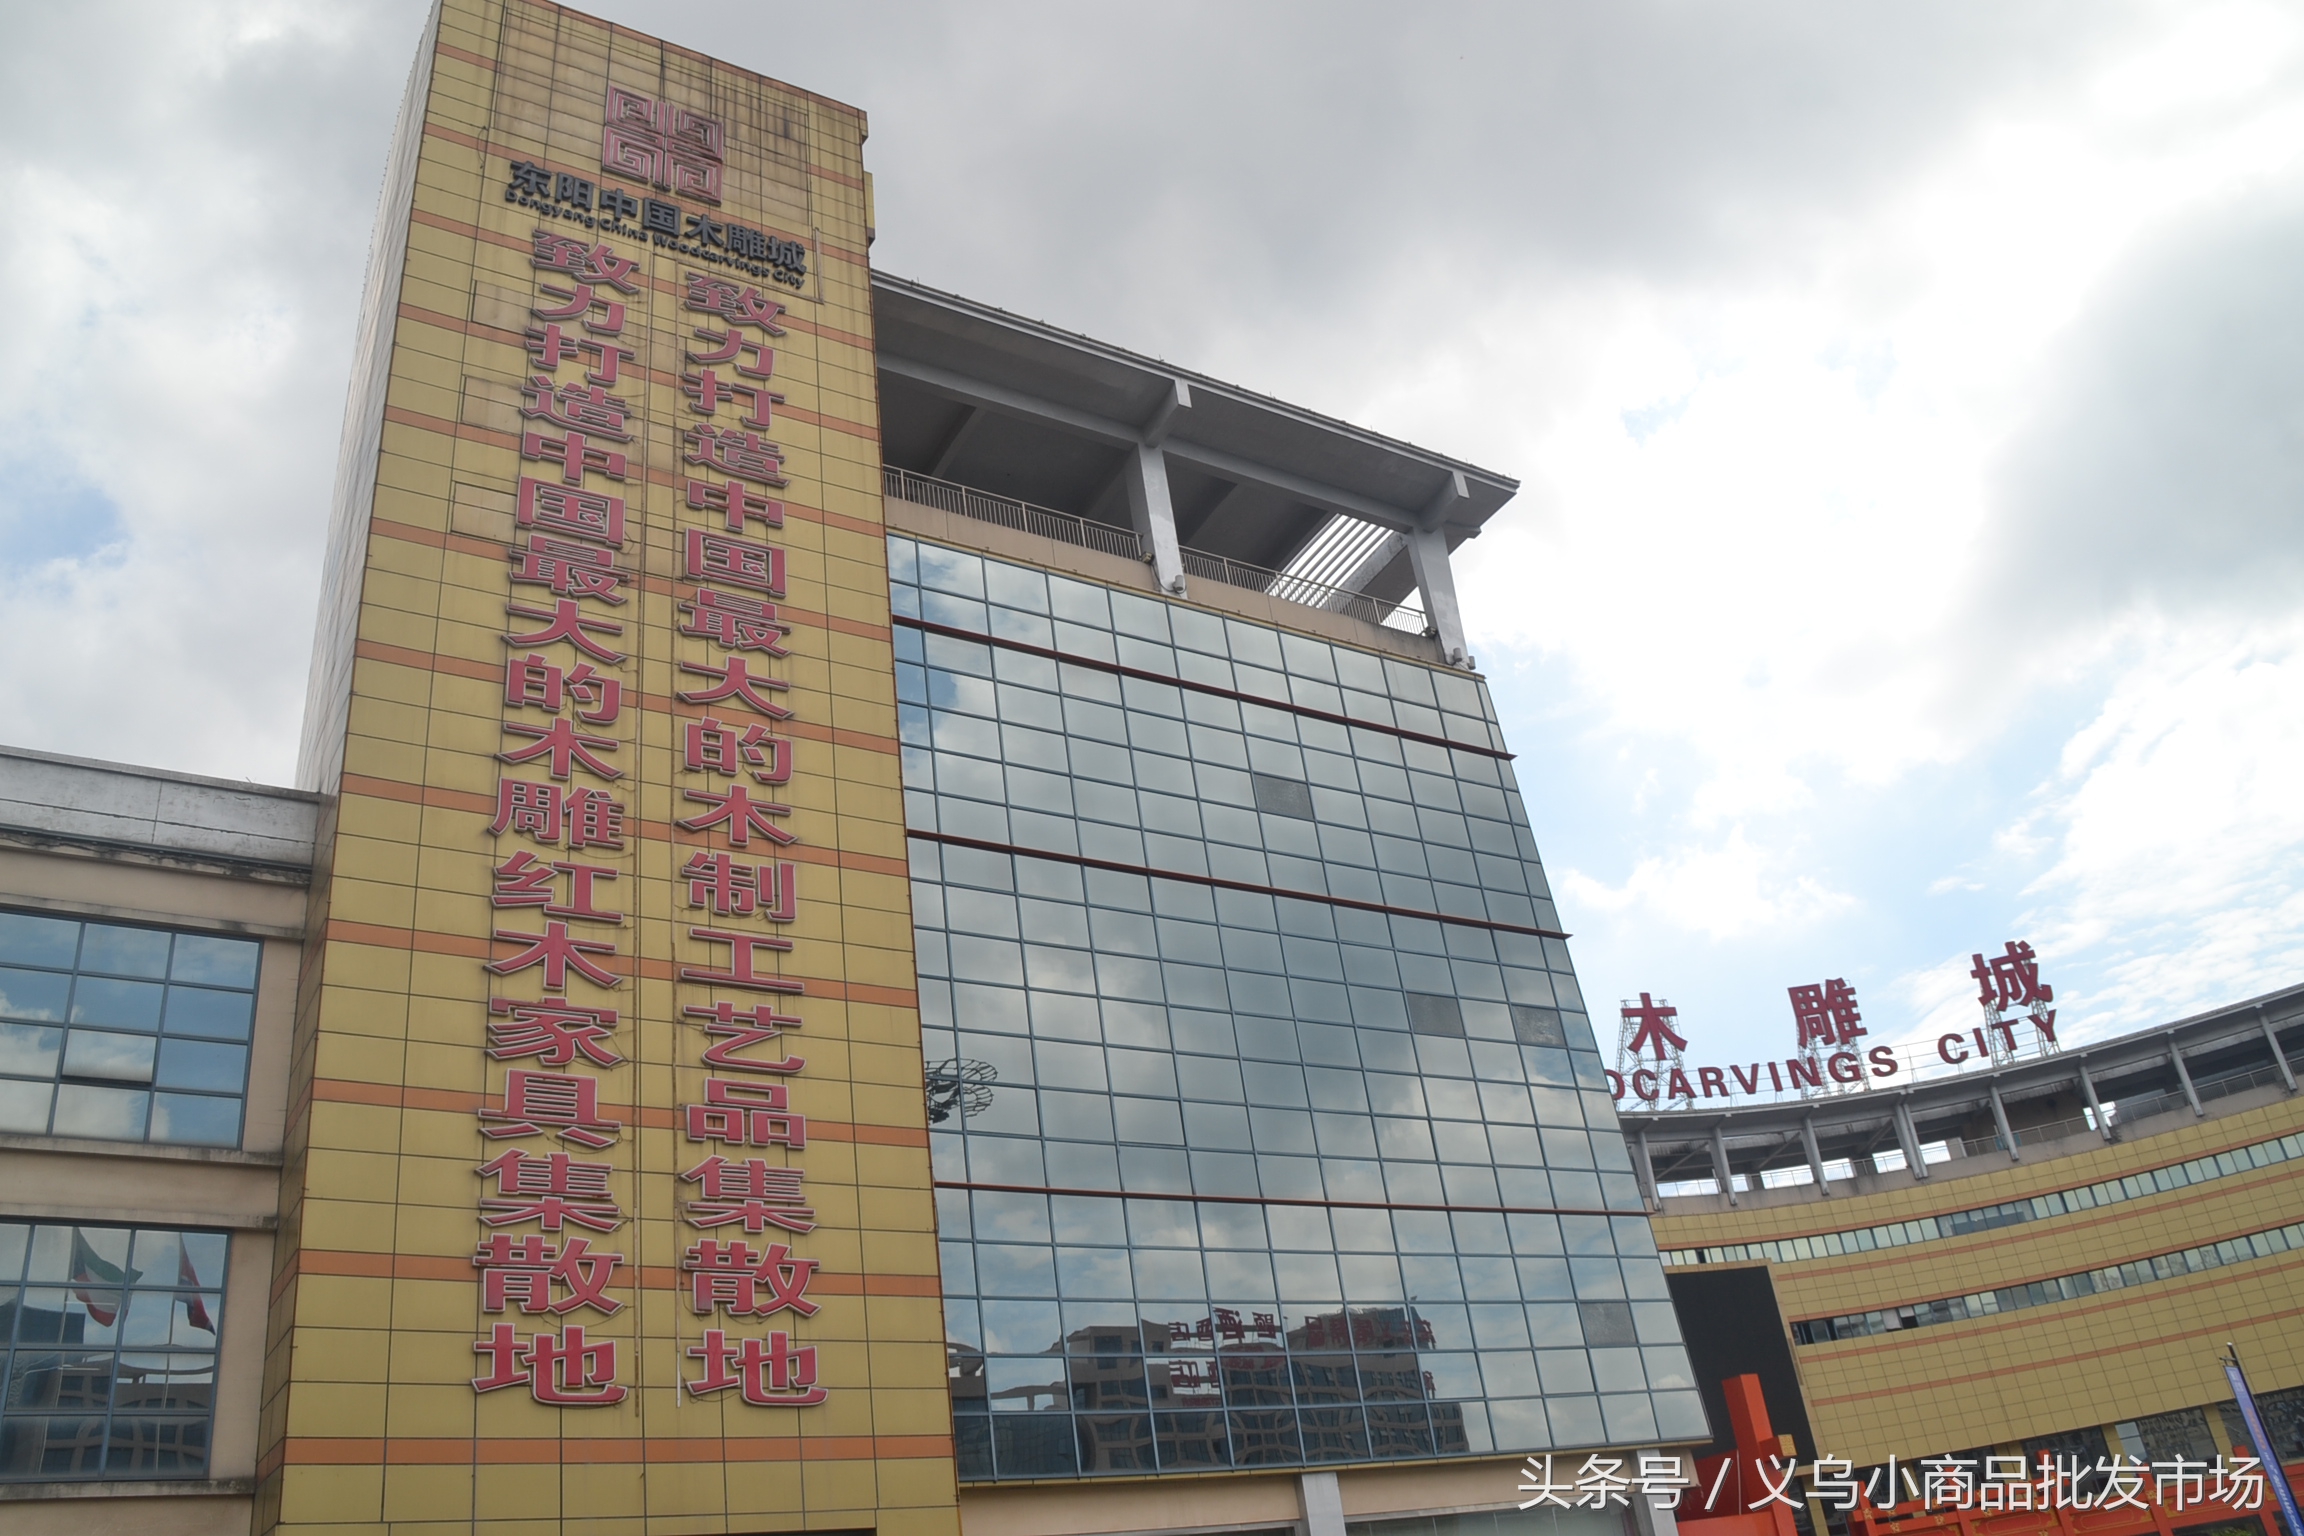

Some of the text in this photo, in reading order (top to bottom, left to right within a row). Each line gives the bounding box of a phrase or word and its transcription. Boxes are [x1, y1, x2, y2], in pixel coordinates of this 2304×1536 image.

[505, 188, 596, 228] Dongyang
[600, 217, 648, 242] China
[773, 268, 805, 289] City
[509, 160, 807, 275] 东阳中国木雕城
[471, 229, 641, 1406] 致力打造中国最大的木雕红木家具集散地
[674, 270, 828, 1406] 致力打造中国最大的木制工艺品集散地
[1621, 940, 2053, 1061] 木雕城
[1937, 1009, 2057, 1064] CITY
